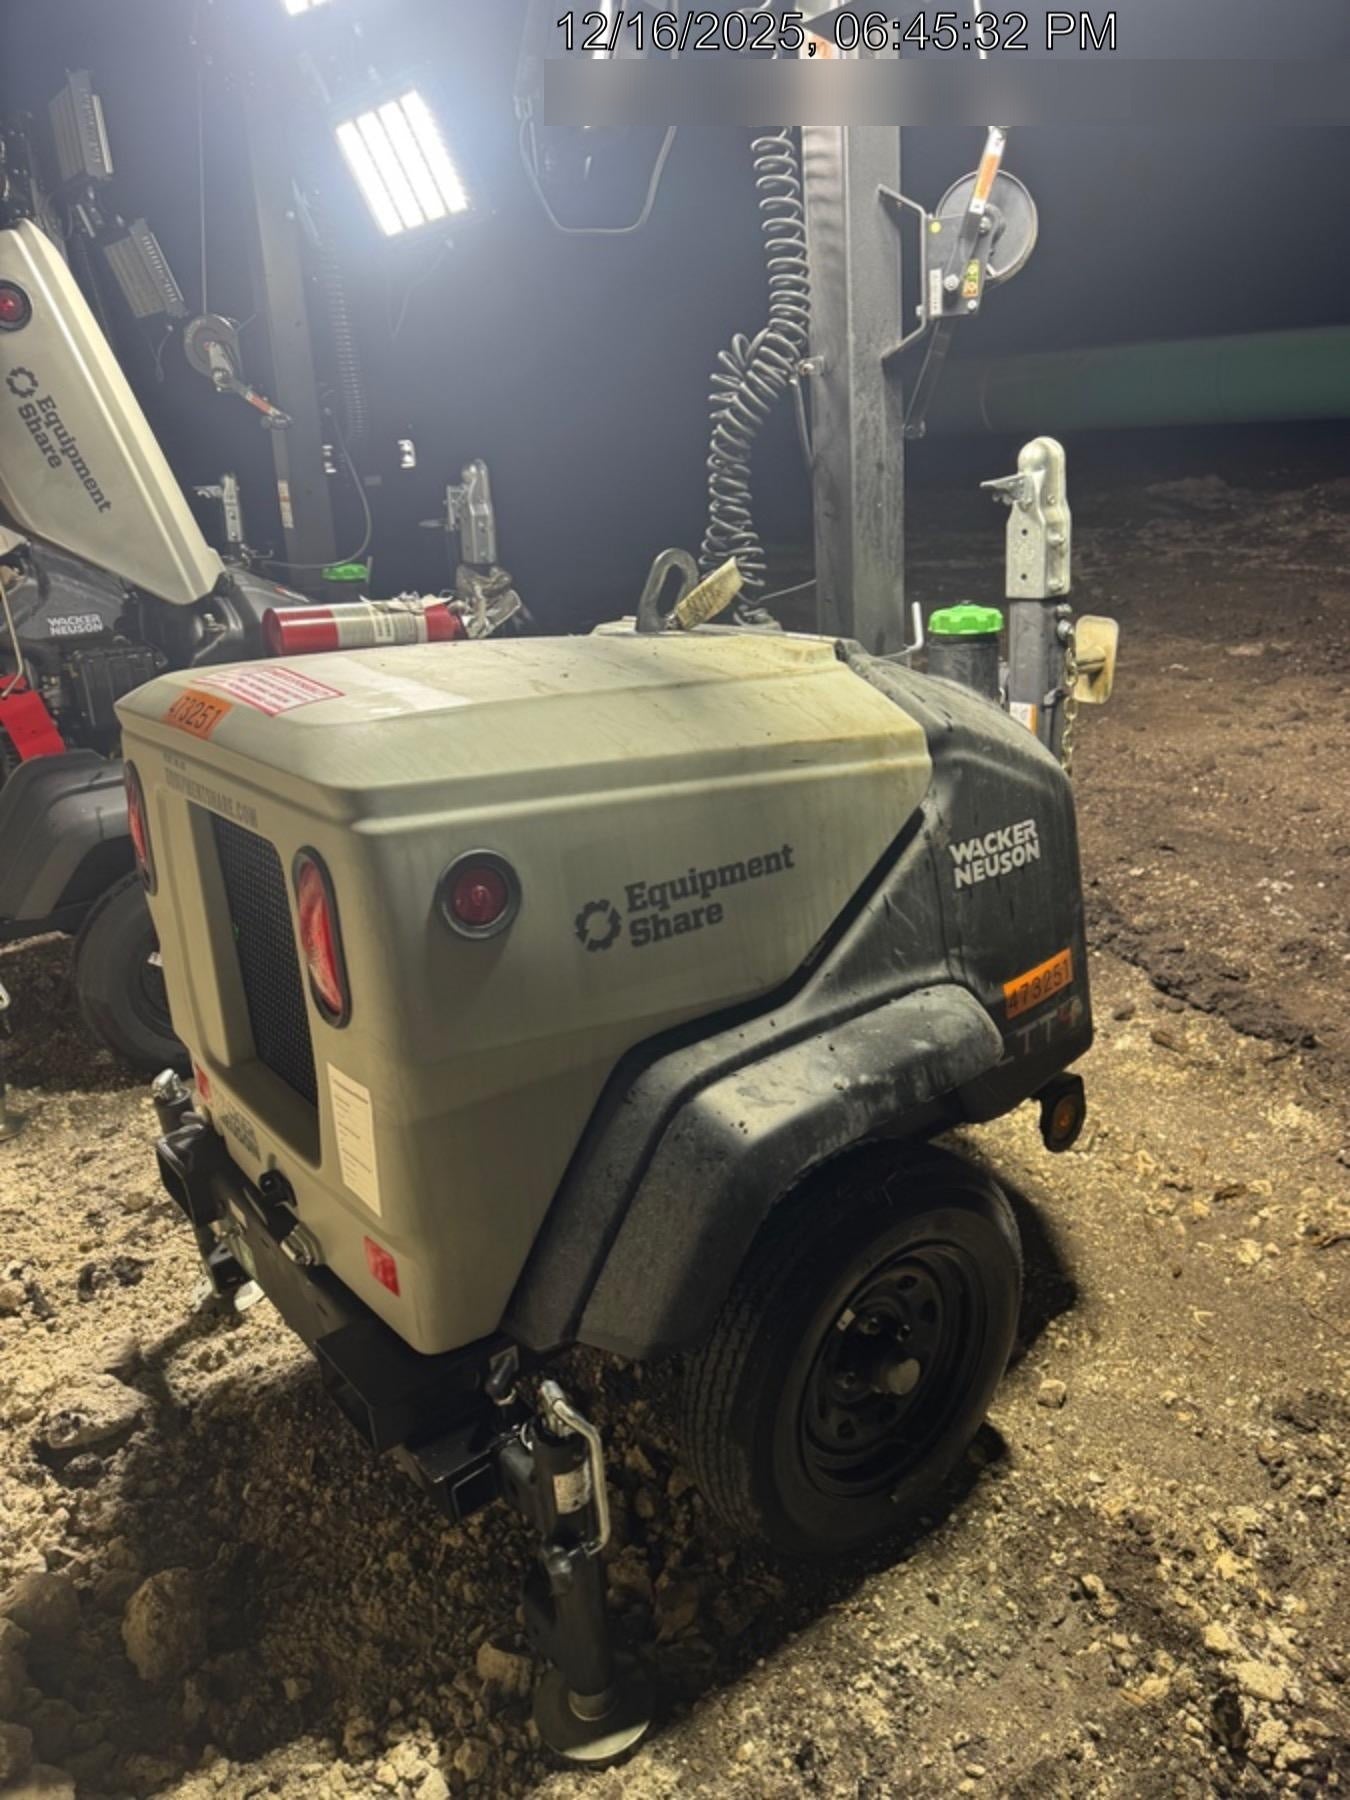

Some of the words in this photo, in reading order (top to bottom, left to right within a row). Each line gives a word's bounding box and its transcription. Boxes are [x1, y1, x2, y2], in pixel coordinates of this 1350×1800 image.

[18, 402, 63, 469] Share
[36, 395, 111, 513] Equipment
[47, 613, 100, 625] WACKER
[50, 623, 103, 636] NEUSON
[949, 818, 1038, 865] WACKER
[953, 839, 1040, 889] NEUSON
[624, 844, 795, 913] Equipment
[629, 902, 724, 948] Share
